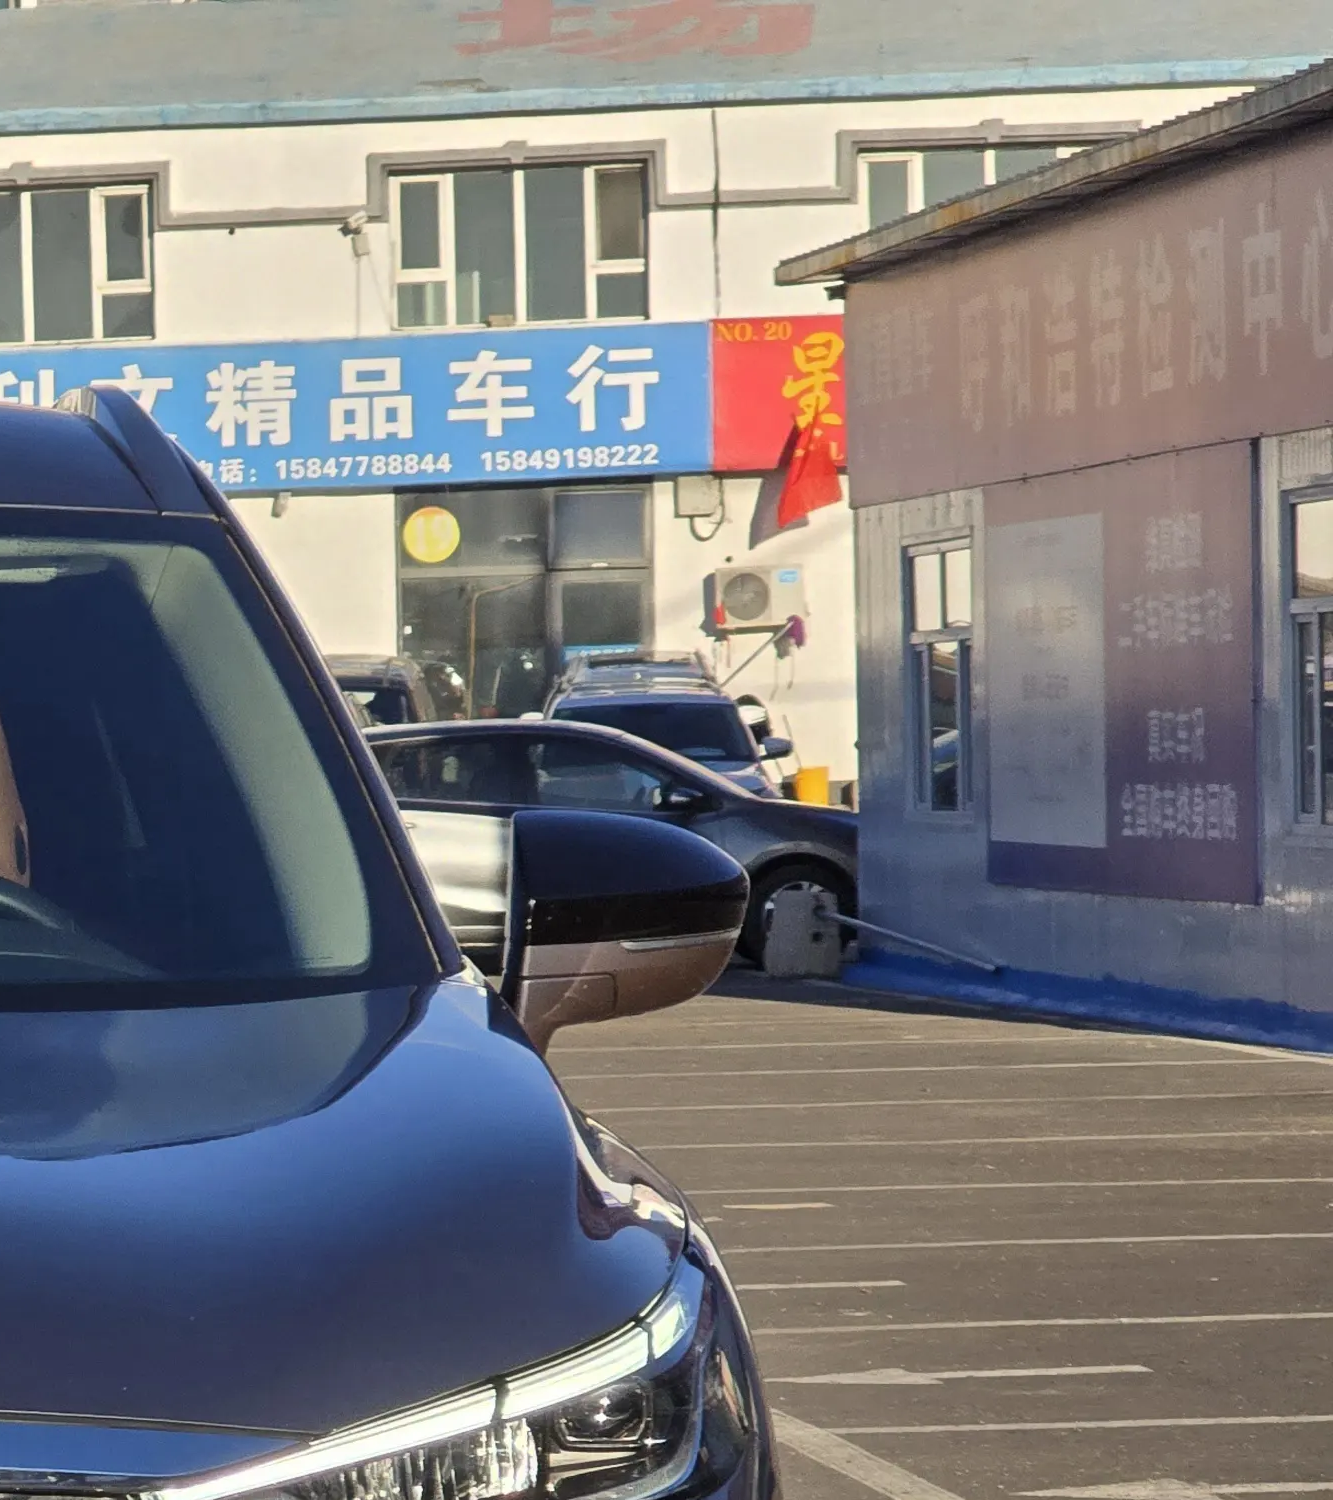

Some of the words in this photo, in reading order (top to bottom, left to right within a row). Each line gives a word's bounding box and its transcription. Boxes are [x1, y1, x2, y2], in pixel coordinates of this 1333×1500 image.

[716, 322, 759, 342] NO.
[763, 321, 793, 341] 20
[275, 453, 453, 481] 15847788844
[481, 443, 659, 473] 15849198222
[416, 515, 454, 554] 19
